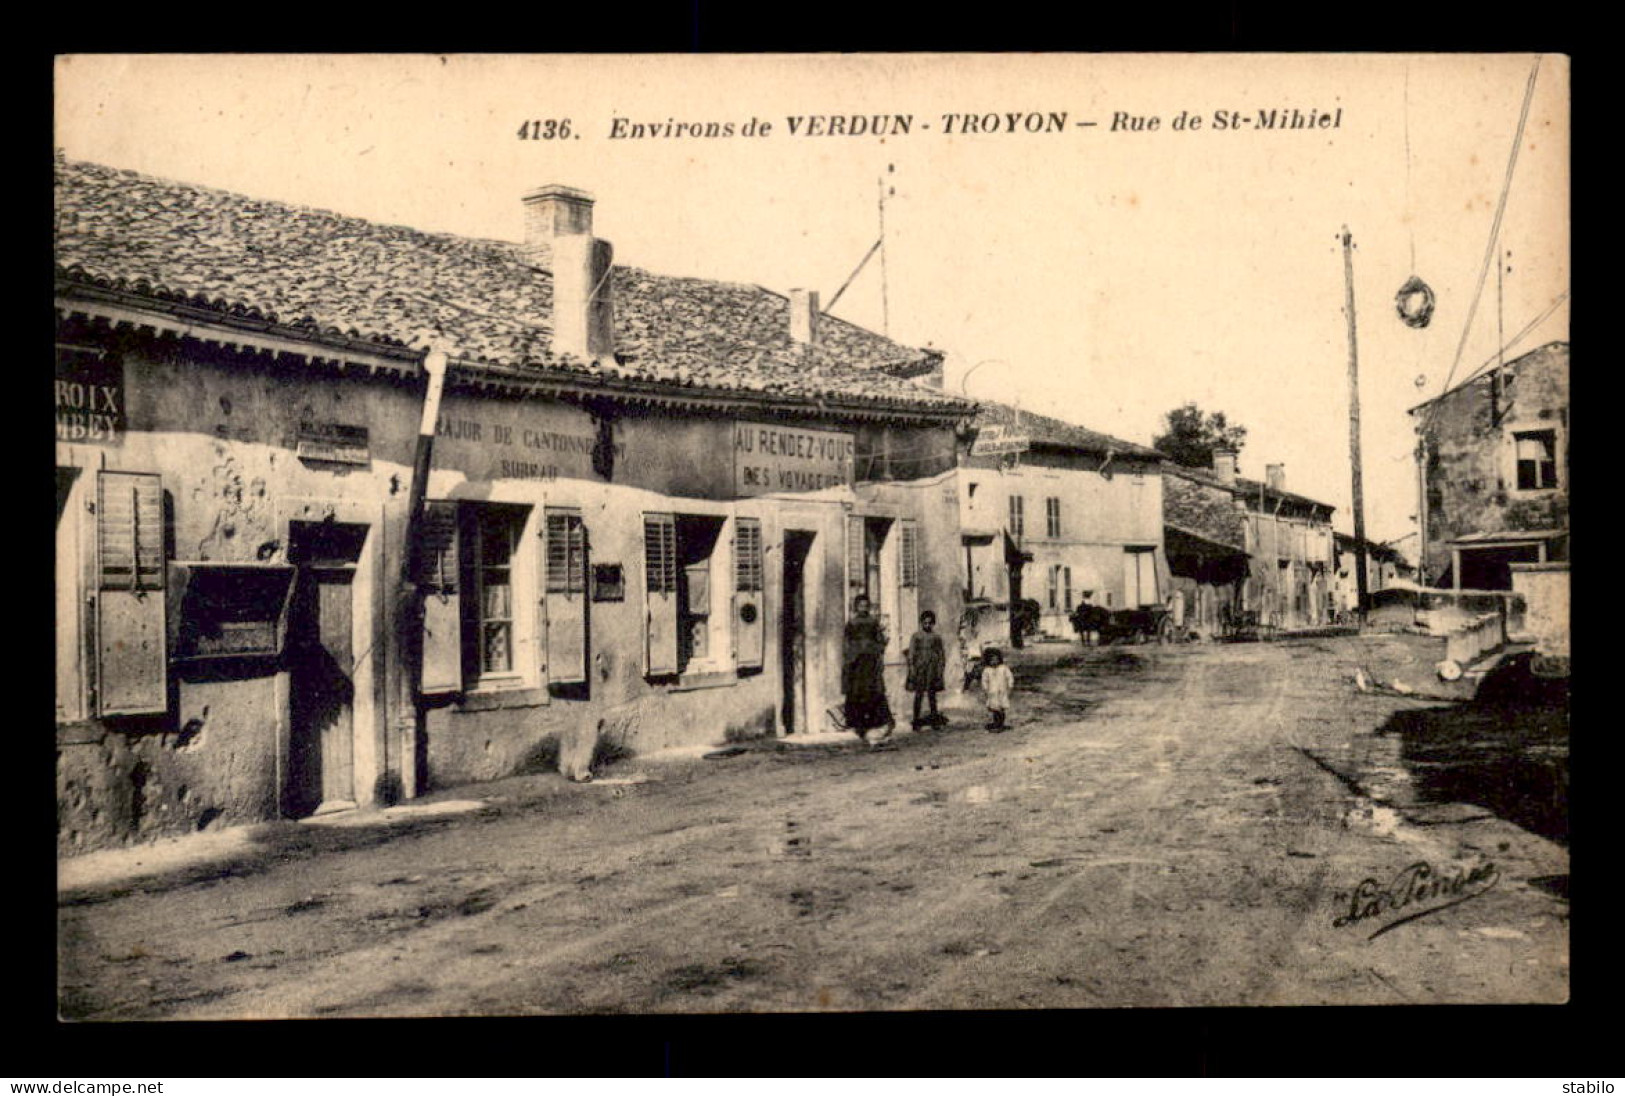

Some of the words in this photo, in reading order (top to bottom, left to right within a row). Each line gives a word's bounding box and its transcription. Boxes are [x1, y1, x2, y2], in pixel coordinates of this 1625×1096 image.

[494, 424, 512, 446] DE
[736, 428, 753, 453] AU
[759, 430, 853, 462] RENDEZ-VOUS
[743, 466, 769, 487] DES
